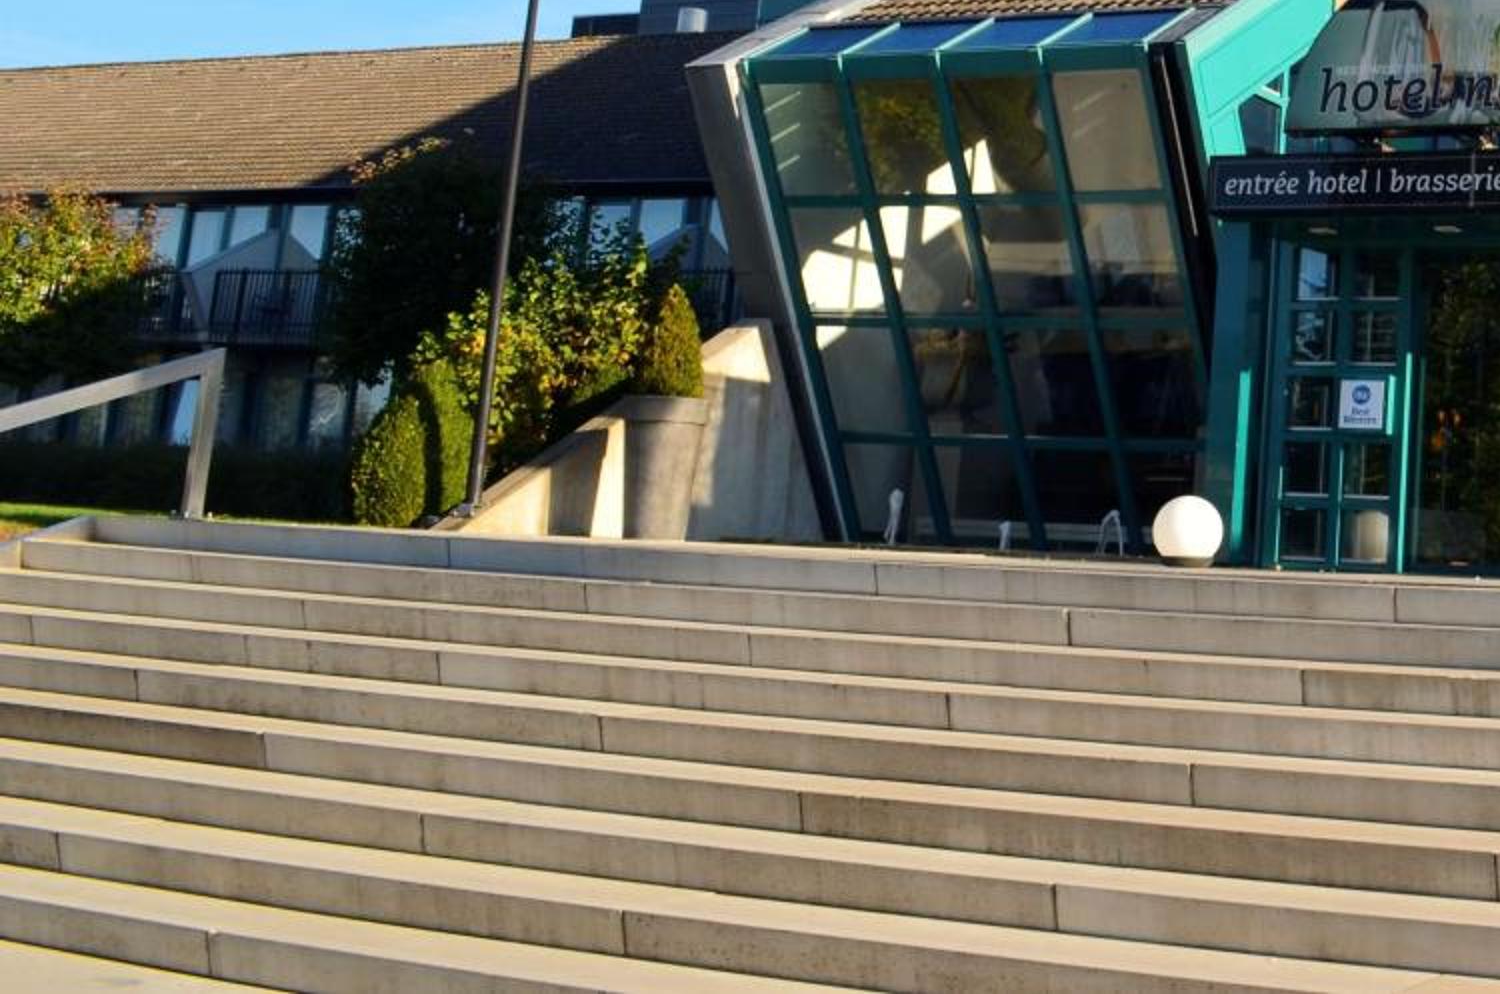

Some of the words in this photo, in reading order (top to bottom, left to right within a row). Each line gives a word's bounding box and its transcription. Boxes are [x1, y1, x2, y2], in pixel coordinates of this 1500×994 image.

[1320, 63, 1444, 113] hotel
[1224, 170, 1299, 195] entrée
[1306, 167, 1367, 194] hotel
